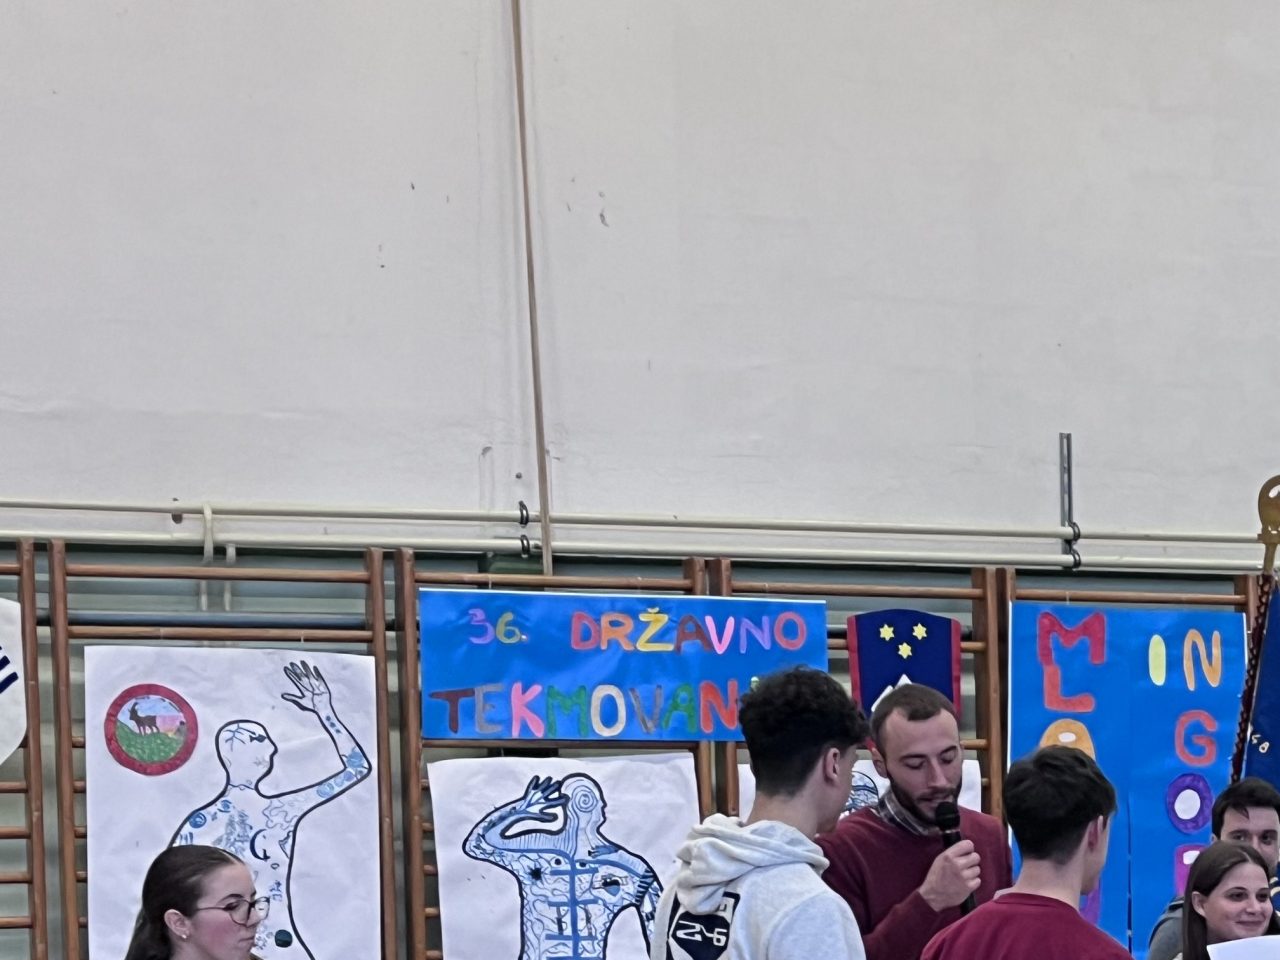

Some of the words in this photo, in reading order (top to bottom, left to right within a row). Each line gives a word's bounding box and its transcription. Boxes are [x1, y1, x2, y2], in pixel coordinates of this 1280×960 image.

[468, 607, 529, 645] 36.
[570, 606, 808, 655] DRŽAVNO
[429, 677, 760, 739] TEKMOVAN
